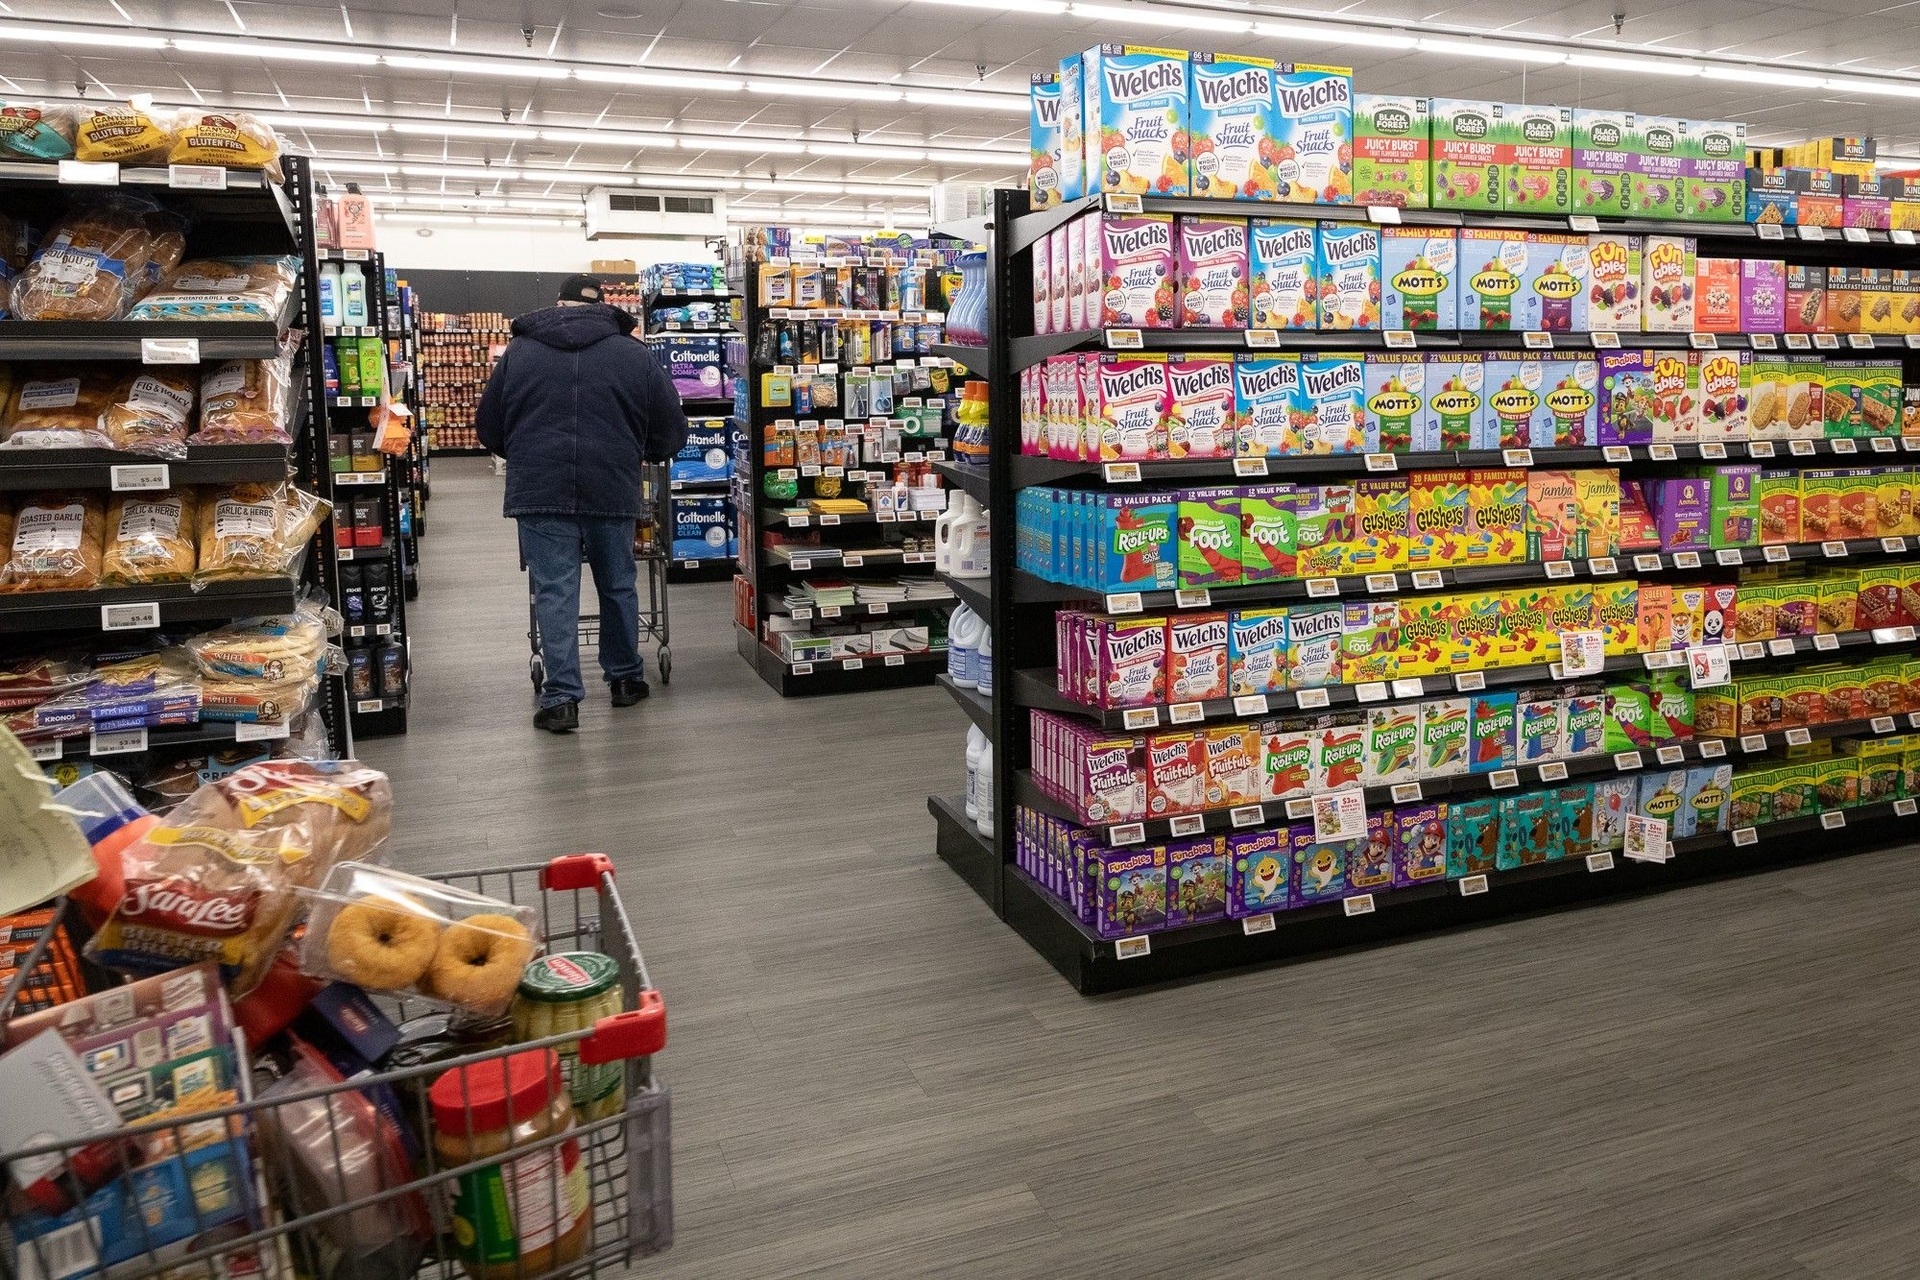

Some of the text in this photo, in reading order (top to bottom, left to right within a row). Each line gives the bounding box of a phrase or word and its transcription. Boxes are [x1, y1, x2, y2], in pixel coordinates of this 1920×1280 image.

[1108, 60, 1182, 97] Welch's
[1198, 72, 1268, 103] Welch's
[1280, 79, 1347, 110] Welch's
[1134, 116, 1163, 130] Fruit
[1378, 112, 1407, 121] BLACK
[1457, 118, 1483, 127] BLACK
[199, 126, 235, 134] CANYON
[1222, 122, 1251, 136] Fruit
[1377, 121, 1409, 129] FOREST
[1455, 125, 1485, 133] FOREST
[90, 129, 122, 141] GLUTEN
[1126, 127, 1168, 140] Snacks
[1215, 133, 1255, 145] Snacks
[1303, 130, 1330, 142] Fruit
[190, 138, 245, 149] GLUTEN FREE
[1296, 139, 1334, 152] Snacks
[1365, 138, 1418, 152] JUICY BURST
[1443, 142, 1495, 155] JUICY BURST
[1514, 147, 1564, 159] JUICY BURST
[1582, 152, 1627, 163] JUICY BURST
[1639, 156, 1682, 168] JUICY BURST
[1694, 160, 1739, 171] JUICY BURST
[1765, 176, 1783, 185] KIND
[1108, 225, 1167, 253] Welch's
[1396, 229, 1426, 238] FAMILY
[1430, 229, 1452, 238] PACK
[1475, 230, 1502, 239] FAMILY
[1505, 231, 1525, 240] PACK
[1187, 228, 1243, 256] Welch's
[1258, 231, 1311, 258] Welch's
[1325, 234, 1376, 260] Welch's
[1277, 271, 1298, 282] Fruit
[1272, 278, 1302, 290] Snacks
[671, 351, 719, 362] Cottonelle
[1376, 354, 1399, 362] VALUE
[1402, 354, 1423, 362] PACK
[1439, 354, 1461, 362] VALUE
[1463, 354, 1481, 362] PACK
[1605, 354, 1641, 366] Funables
[1103, 367, 1163, 397] Welch's
[1172, 367, 1230, 397] Welch's
[1241, 367, 1296, 395] Welch's
[1305, 366, 1360, 394] Welch's
[136, 381, 152, 391] FIG
[161, 389, 189, 407] HONEY
[1414, 472, 1465, 483] 20 FAMILY PACK
[1370, 482, 1389, 490] VALUE
[1538, 483, 1573, 502] jamba
[1585, 481, 1616, 499] jamba
[1125, 496, 1148, 504] VALUE
[20, 513, 82, 524] ROASTED GARLIC
[155, 506, 179, 518] HERBS
[677, 512, 725, 523] Cottonelle
[1644, 590, 1666, 599] SOLELY
[1237, 618, 1282, 646] Welch's
[1293, 615, 1340, 636] Welch's
[1175, 626, 1226, 647] Welch's
[1111, 630, 1162, 660] Welch's
[214, 653, 243, 662] WHITE
[164, 698, 190, 706] ORIGINAL
[100, 705, 143, 715] PITA BREAD
[45, 714, 76, 722] KRONOS
[1208, 734, 1241, 755] Welch's
[1153, 742, 1186, 763] Welch's
[1090, 750, 1125, 770] Welch's
[1209, 755, 1251, 774] Fruitfuls
[1154, 762, 1196, 786] Fruitfuls
[1090, 772, 1136, 793] Fruitfuls
[1402, 809, 1435, 826] Funables
[1236, 837, 1276, 856] Funables
[1170, 845, 1212, 863] Funables
[1108, 856, 1152, 874] Funables
